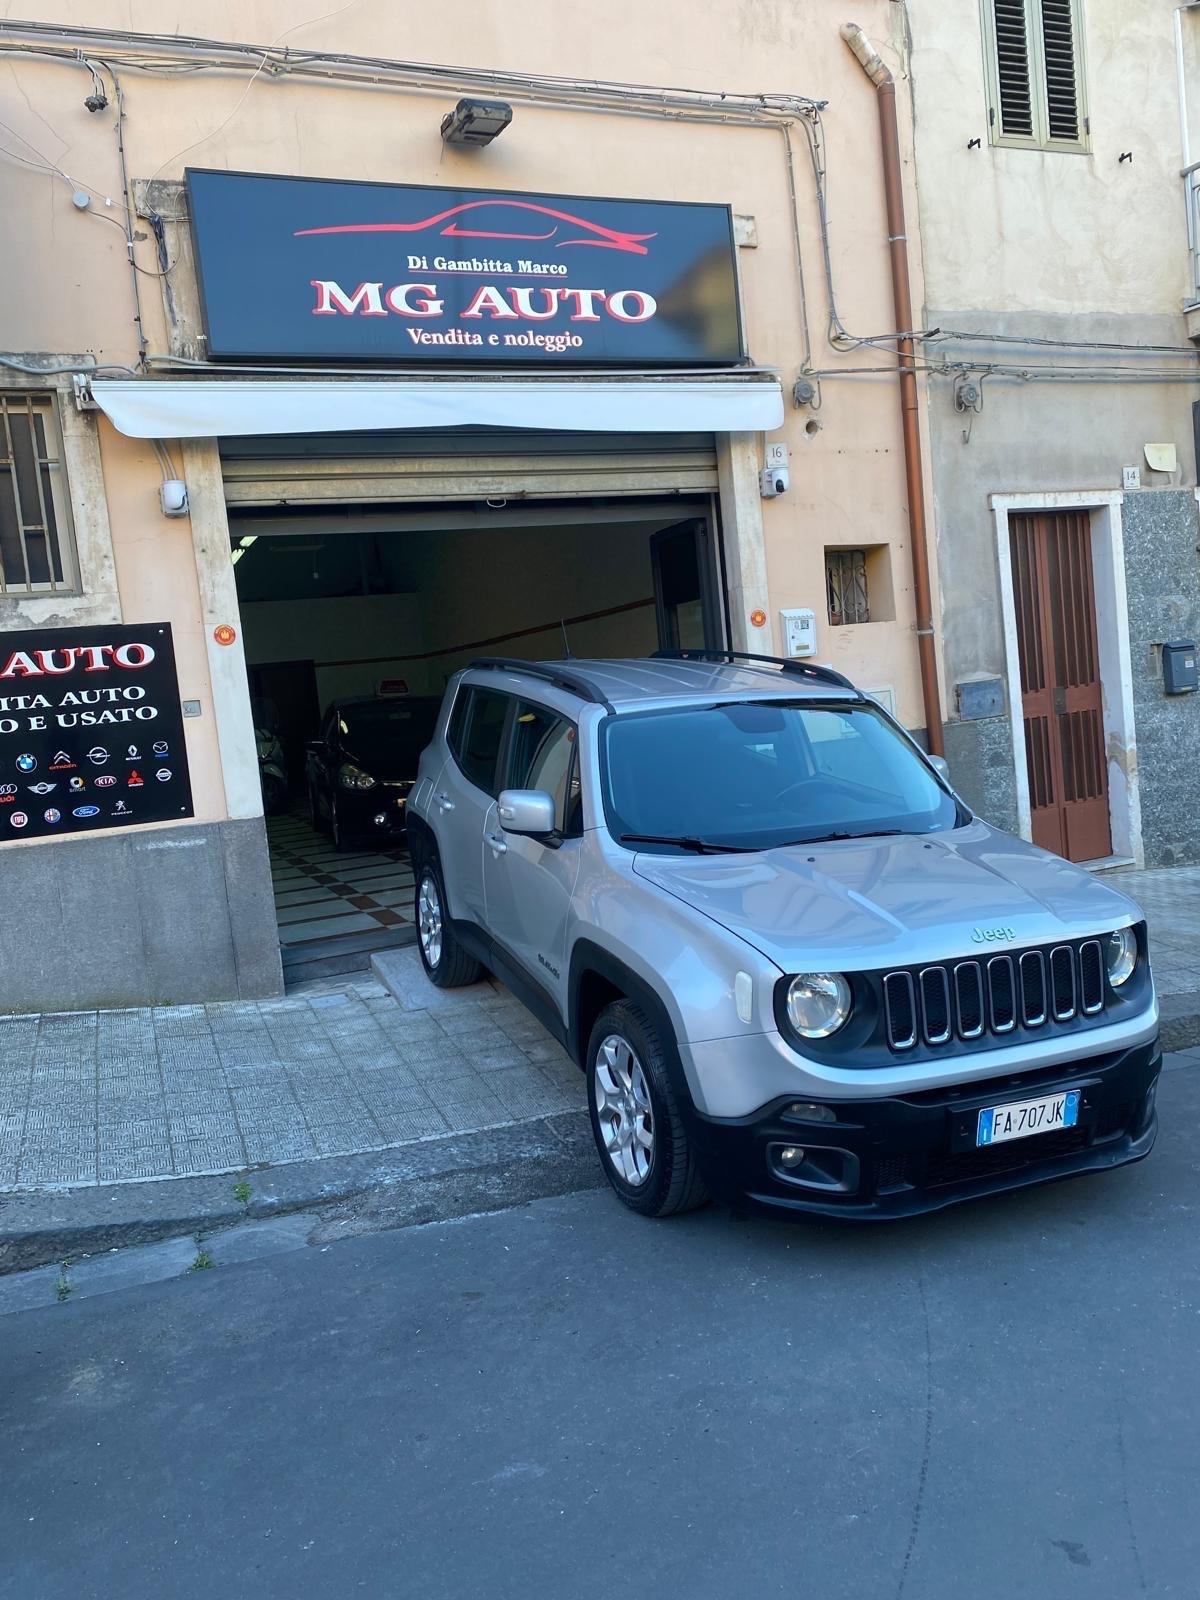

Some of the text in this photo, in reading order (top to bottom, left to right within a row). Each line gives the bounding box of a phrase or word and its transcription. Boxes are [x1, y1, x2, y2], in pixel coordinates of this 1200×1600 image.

[407, 255, 568, 275] Di Gambitta Marco
[310, 280, 657, 323] MG AUTO
[406, 328, 583, 352] Vendita e noleggio
[772, 446, 782, 458] 16
[1127, 471, 1136, 480] 14
[0, 643, 156, 678] AUTO
[59, 686, 146, 707] AUTO
[28, 716, 47, 730] E
[56, 706, 158, 728] USATO
[970, 927, 1016, 943] Jeep
